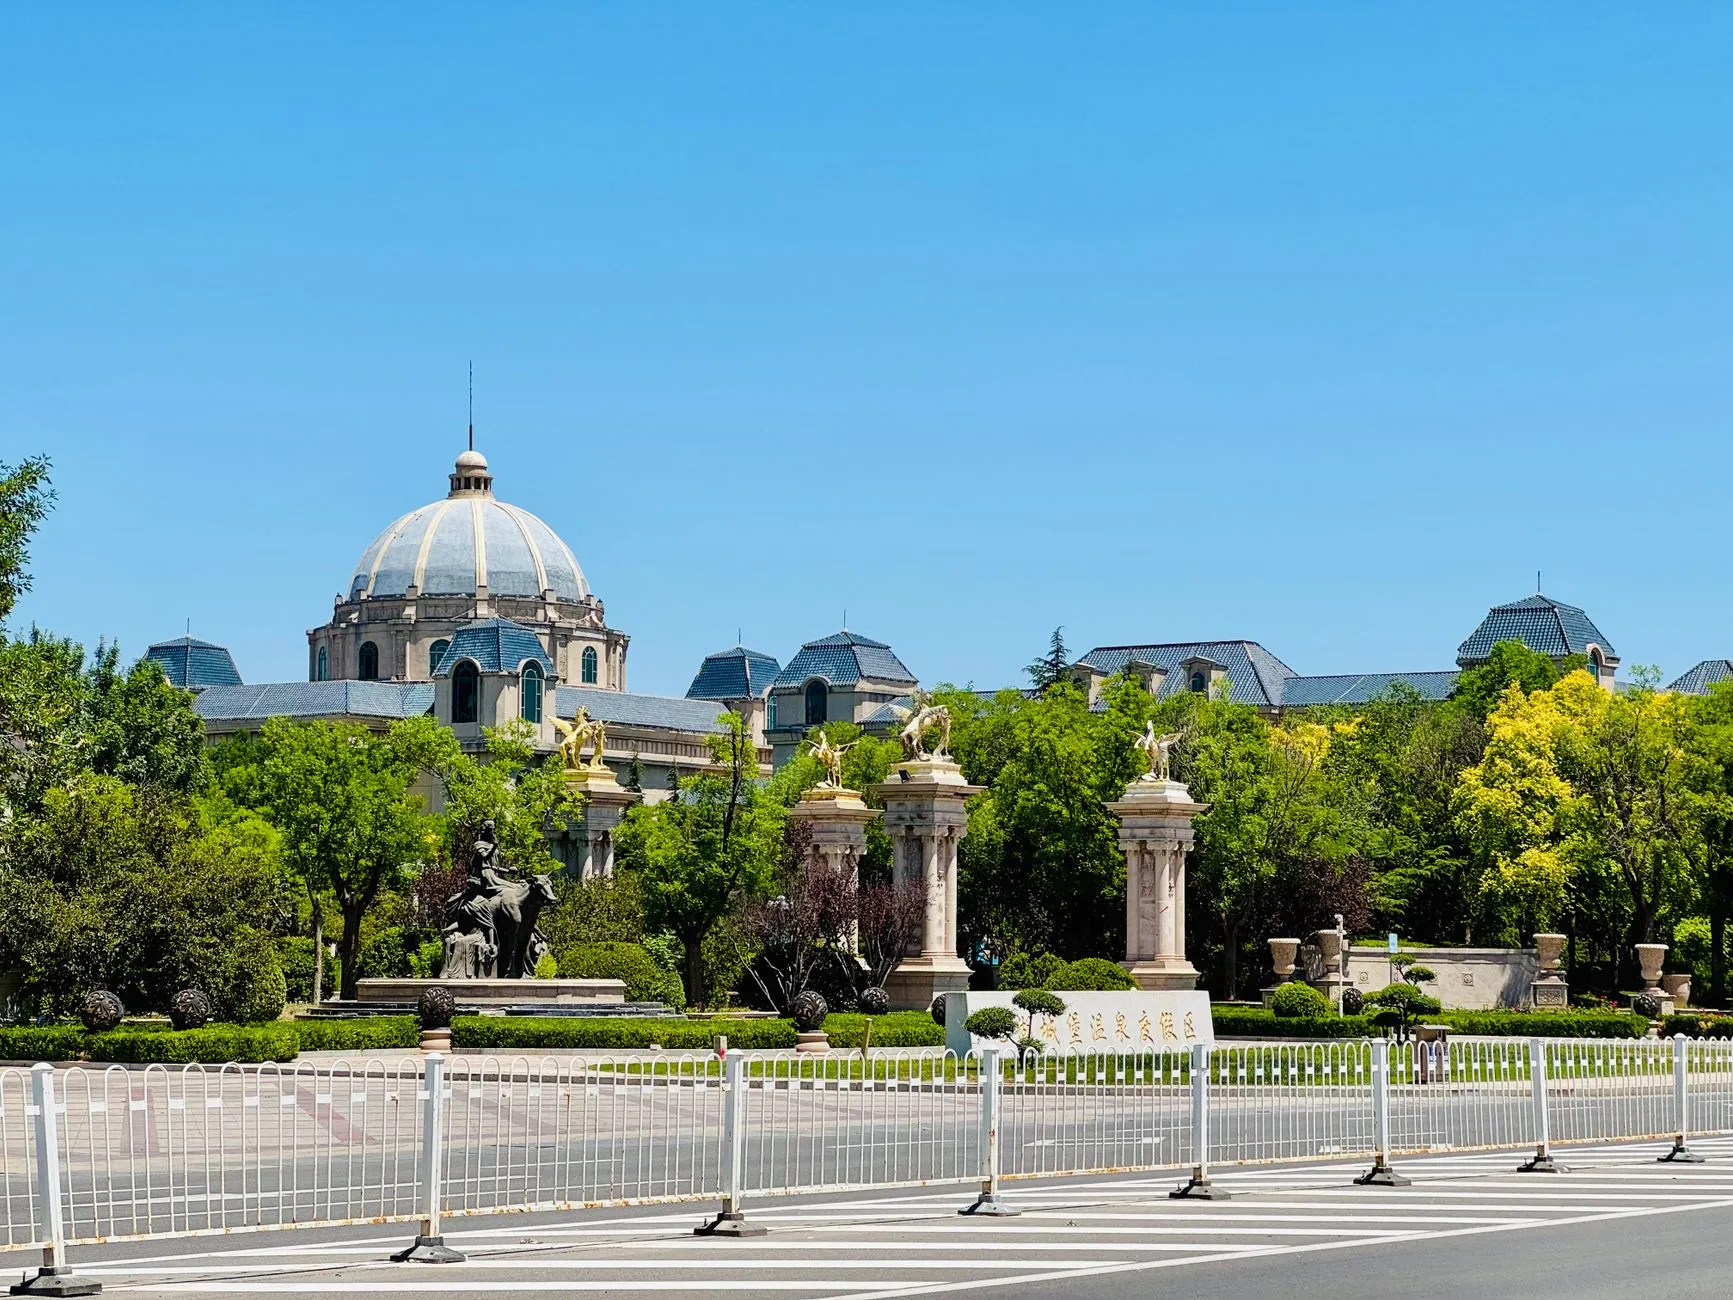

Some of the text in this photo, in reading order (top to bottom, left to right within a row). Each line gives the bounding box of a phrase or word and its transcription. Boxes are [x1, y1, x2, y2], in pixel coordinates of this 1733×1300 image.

[1000, 1011, 1196, 1045] 城堡温泉度假区
